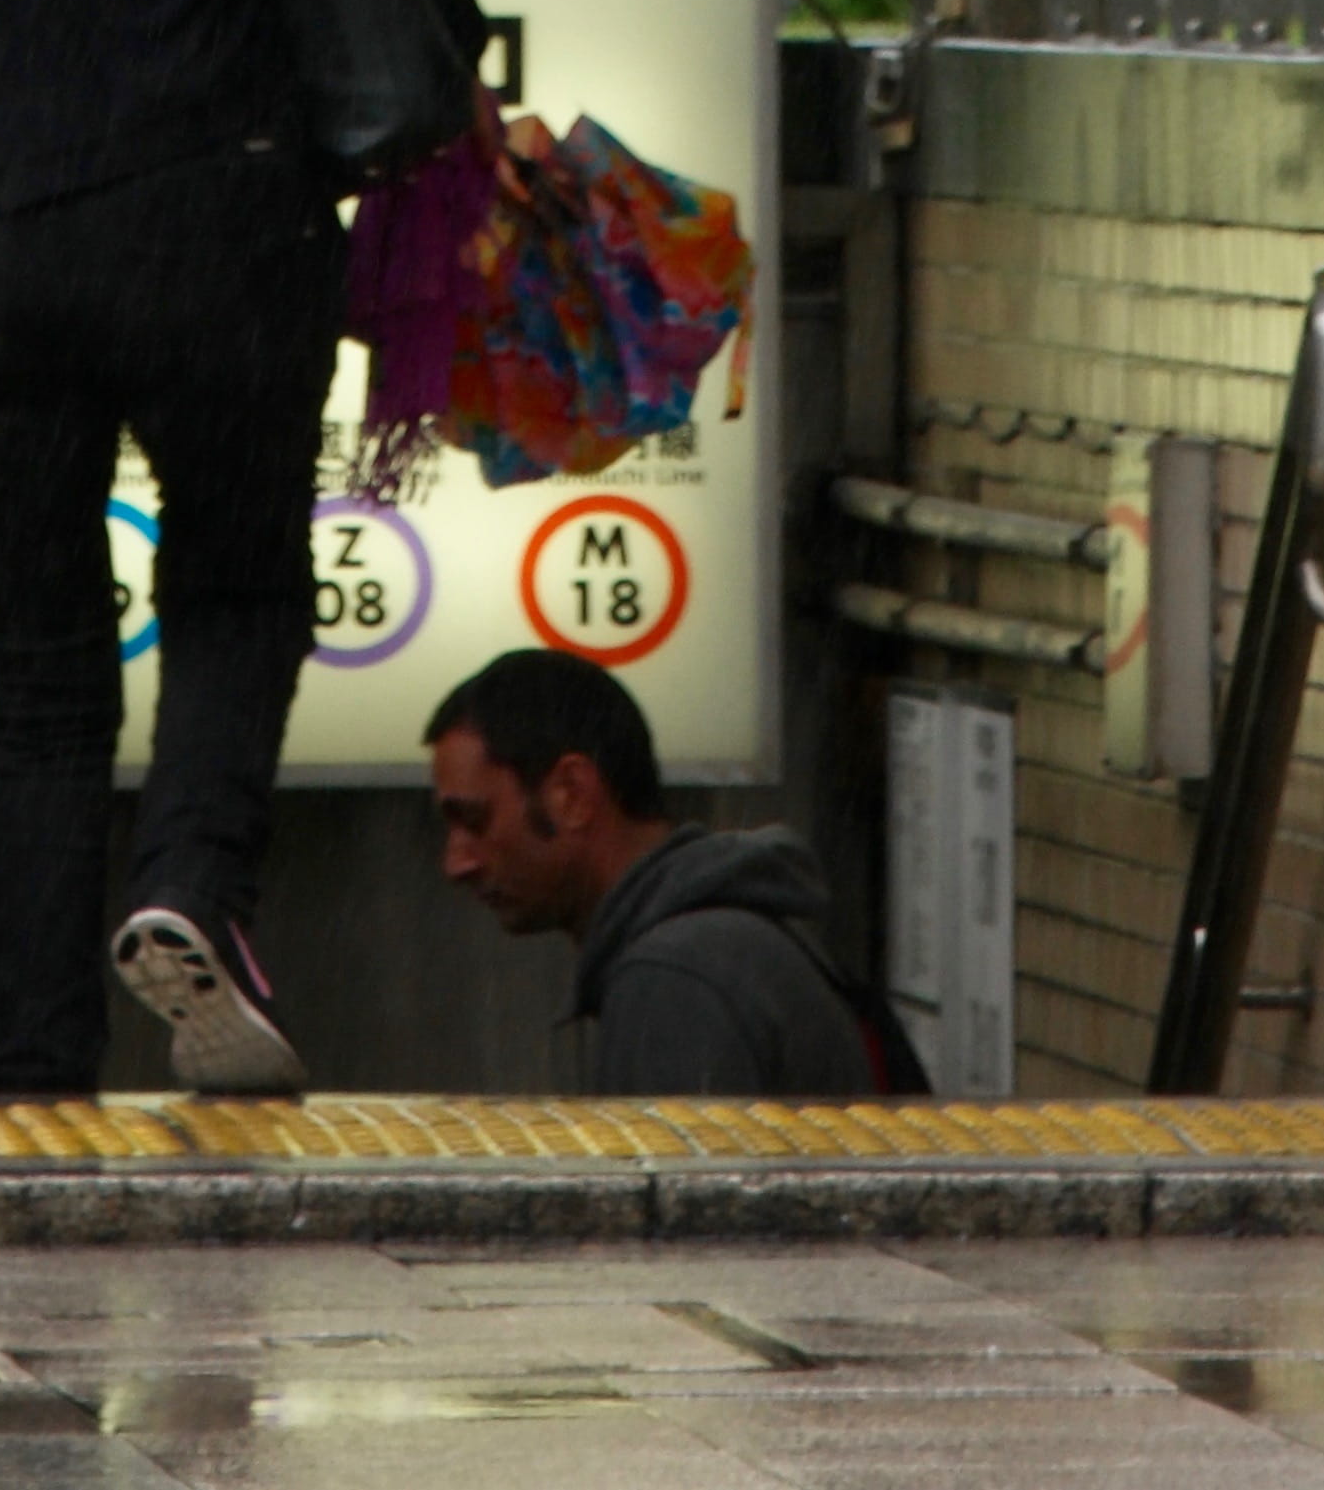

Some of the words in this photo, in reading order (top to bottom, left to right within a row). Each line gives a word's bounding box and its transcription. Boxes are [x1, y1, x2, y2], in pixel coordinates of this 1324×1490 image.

[334, 526, 365, 569] Z
[579, 525, 629, 567] M
[314, 579, 388, 628] 08
[570, 578, 643, 628] 18
